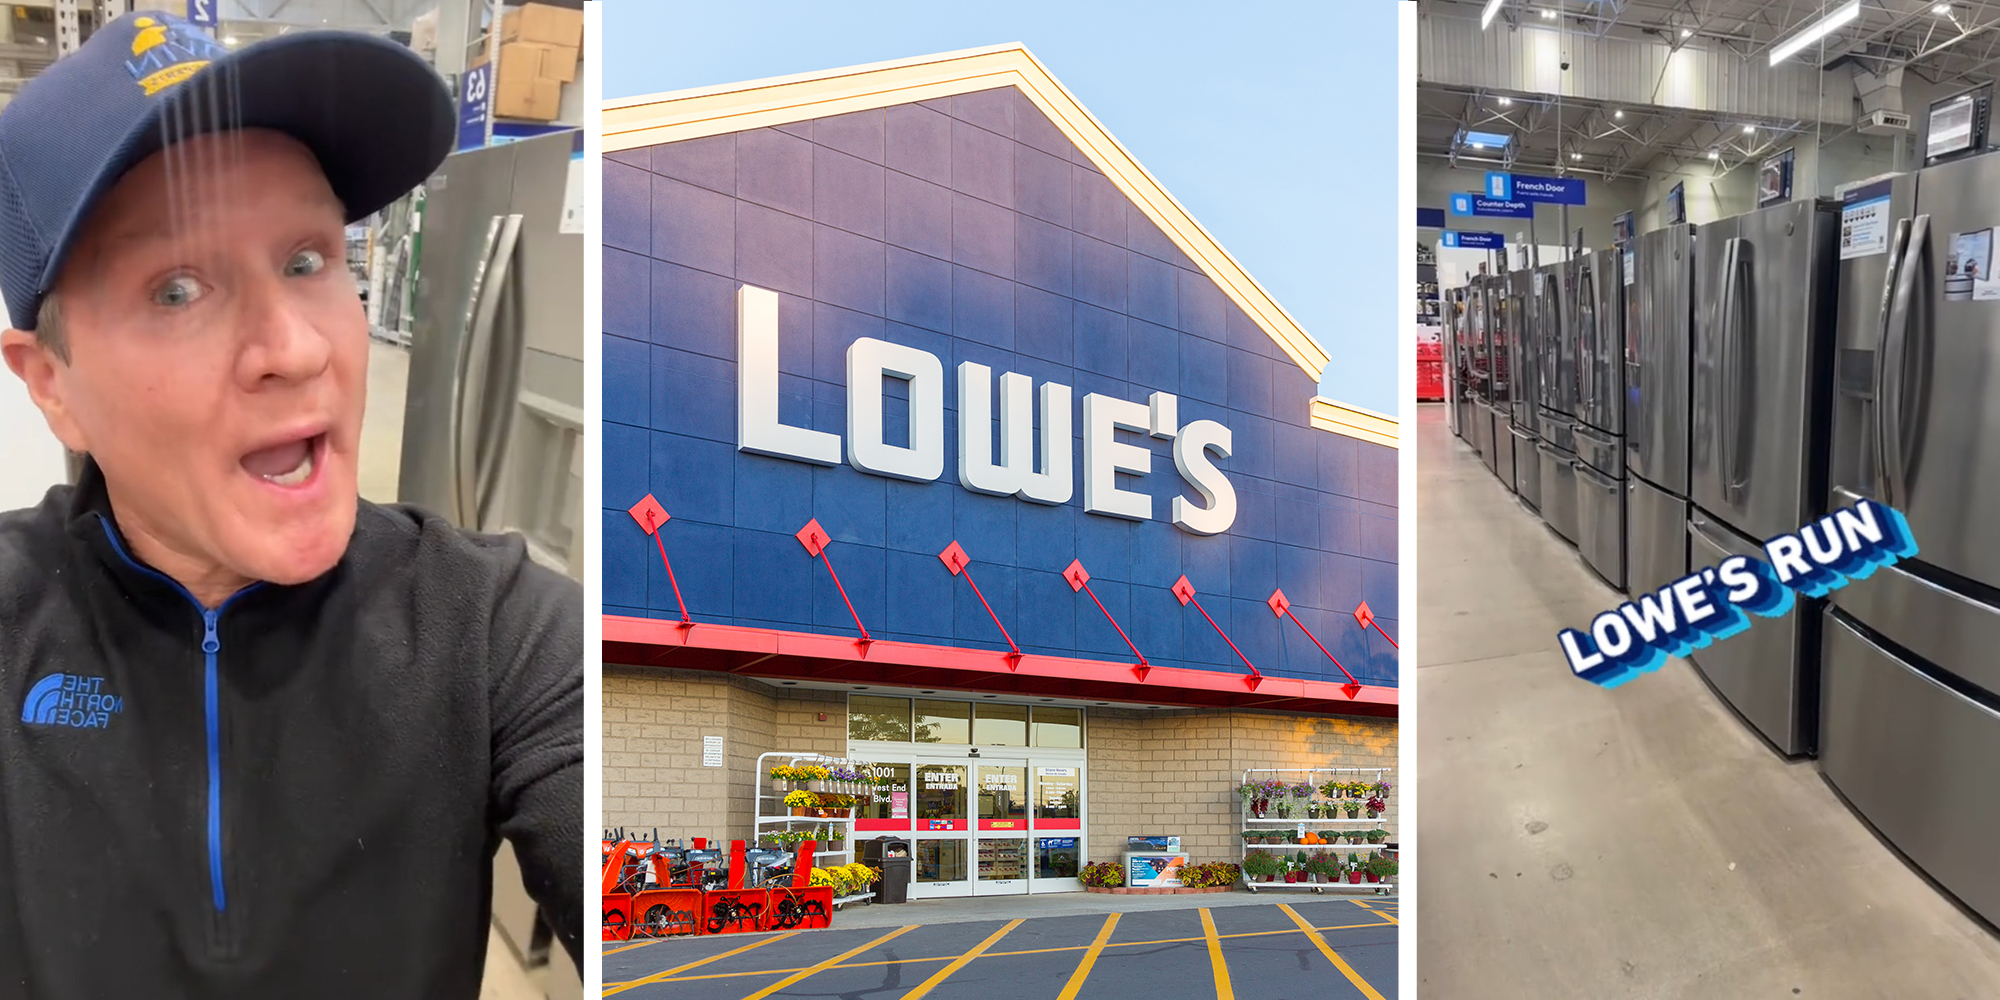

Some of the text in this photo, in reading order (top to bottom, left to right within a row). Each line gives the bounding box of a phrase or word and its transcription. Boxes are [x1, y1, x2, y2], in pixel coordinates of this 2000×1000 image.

[1516, 181, 1565, 192] French Door
[1476, 199, 1526, 209] Counter Depth
[738, 284, 1237, 536] LOWE'S
[872, 767, 895, 778] 1001
[924, 772, 959, 783] ENTER
[985, 774, 1017, 784] ENTER
[892, 784, 906, 792] End
[873, 795, 892, 803] Blvd.
